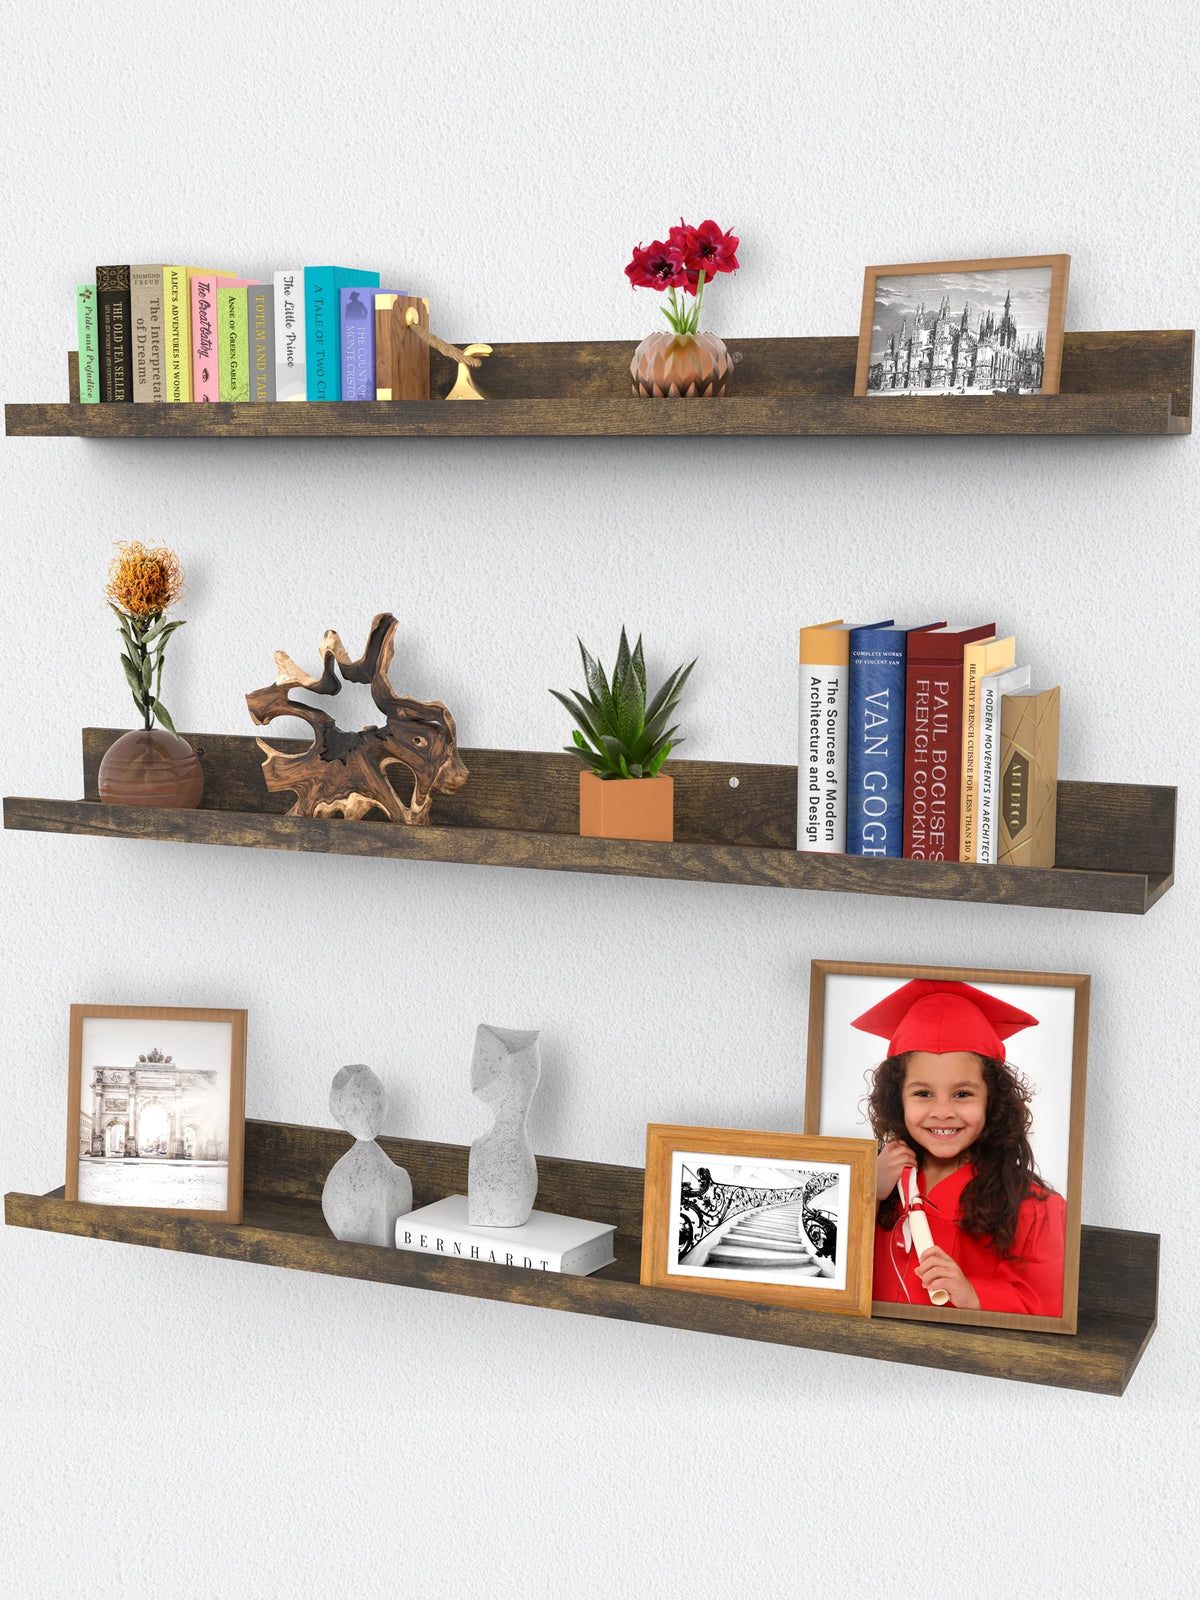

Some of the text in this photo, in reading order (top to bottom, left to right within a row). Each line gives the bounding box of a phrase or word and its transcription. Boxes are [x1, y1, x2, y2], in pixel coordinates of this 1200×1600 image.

[150, 297, 160, 322] The
[314, 284, 323, 293] A
[314, 297, 324, 326] TALE
[171, 304, 179, 359] ADVENTURES
[197, 281, 212, 359] The Great Gatsby
[283, 276, 297, 369] The Little Prince
[315, 330, 324, 345] OF
[357, 326, 366, 347] THE
[84, 306, 96, 399] Pride and Prejudice
[113, 302, 125, 401] THE OLD TEA SELLER
[136, 317, 147, 385] of Dreams
[173, 361, 179, 371] IN
[255, 295, 267, 403] TOTEM AND TAB
[316, 349, 326, 377] TWO
[345, 325, 356, 399] MONTE CRISTO
[968, 663, 977, 701] HEALTHY
[864, 688, 890, 758] VAN
[914, 679, 930, 764] FRENCH
[932, 680, 950, 742] PAUL
[967, 704, 976, 738] FRENCH
[806, 676, 822, 843] Architecture and Design
[825, 678, 839, 842] The Sources of Modern
[967, 739, 975, 774] CUISINE
[981, 688, 994, 864] MODERN MOVEMENTS IN ARCHITECT
[965, 794, 973, 813] LESS
[966, 775, 974, 793] FOR
[1009, 762, 1022, 830] ART DECO
[964, 840, 972, 854] $10
[965, 815, 973, 839] THAN
[404, 1231, 549, 1271] BERNHARDT
